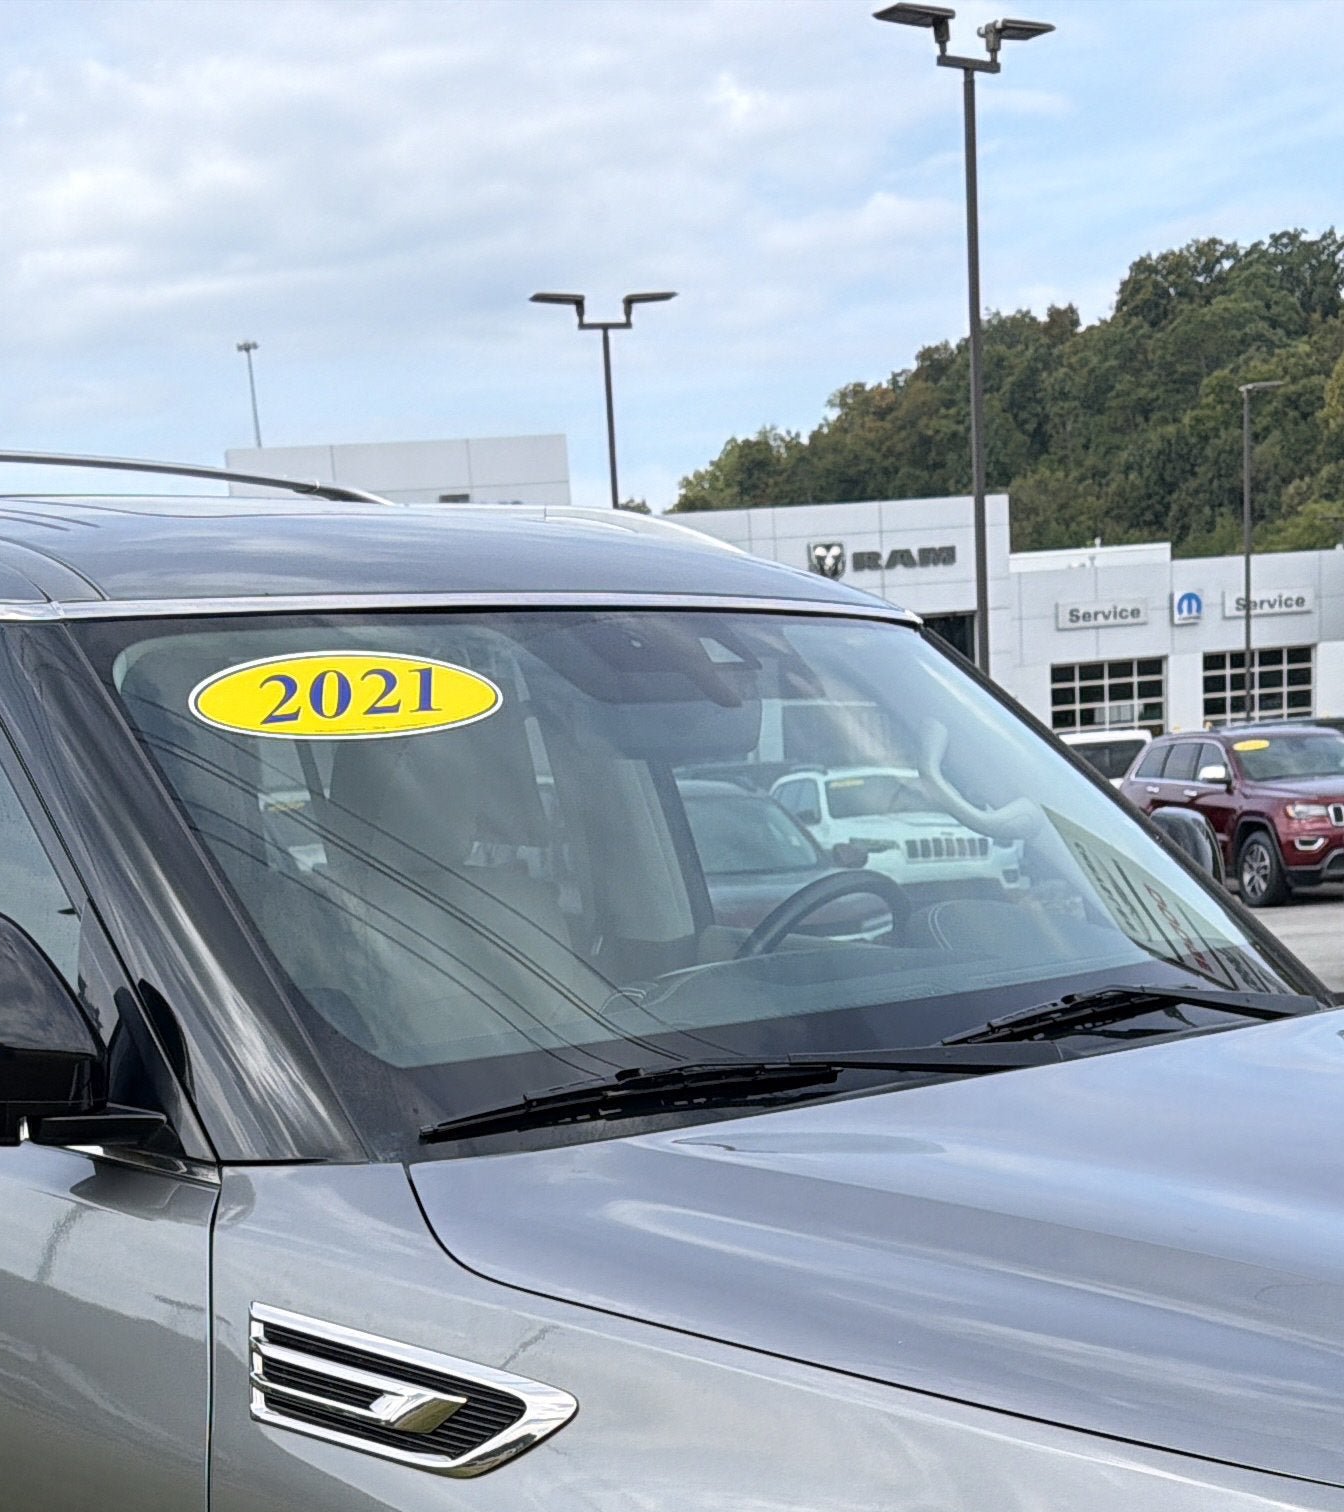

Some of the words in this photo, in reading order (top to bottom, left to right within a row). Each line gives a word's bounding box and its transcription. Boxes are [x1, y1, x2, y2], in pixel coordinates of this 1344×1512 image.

[852, 545, 957, 572] RAM
[1234, 594, 1306, 612] Service
[1068, 606, 1141, 624] Service
[258, 666, 443, 726] 2021
